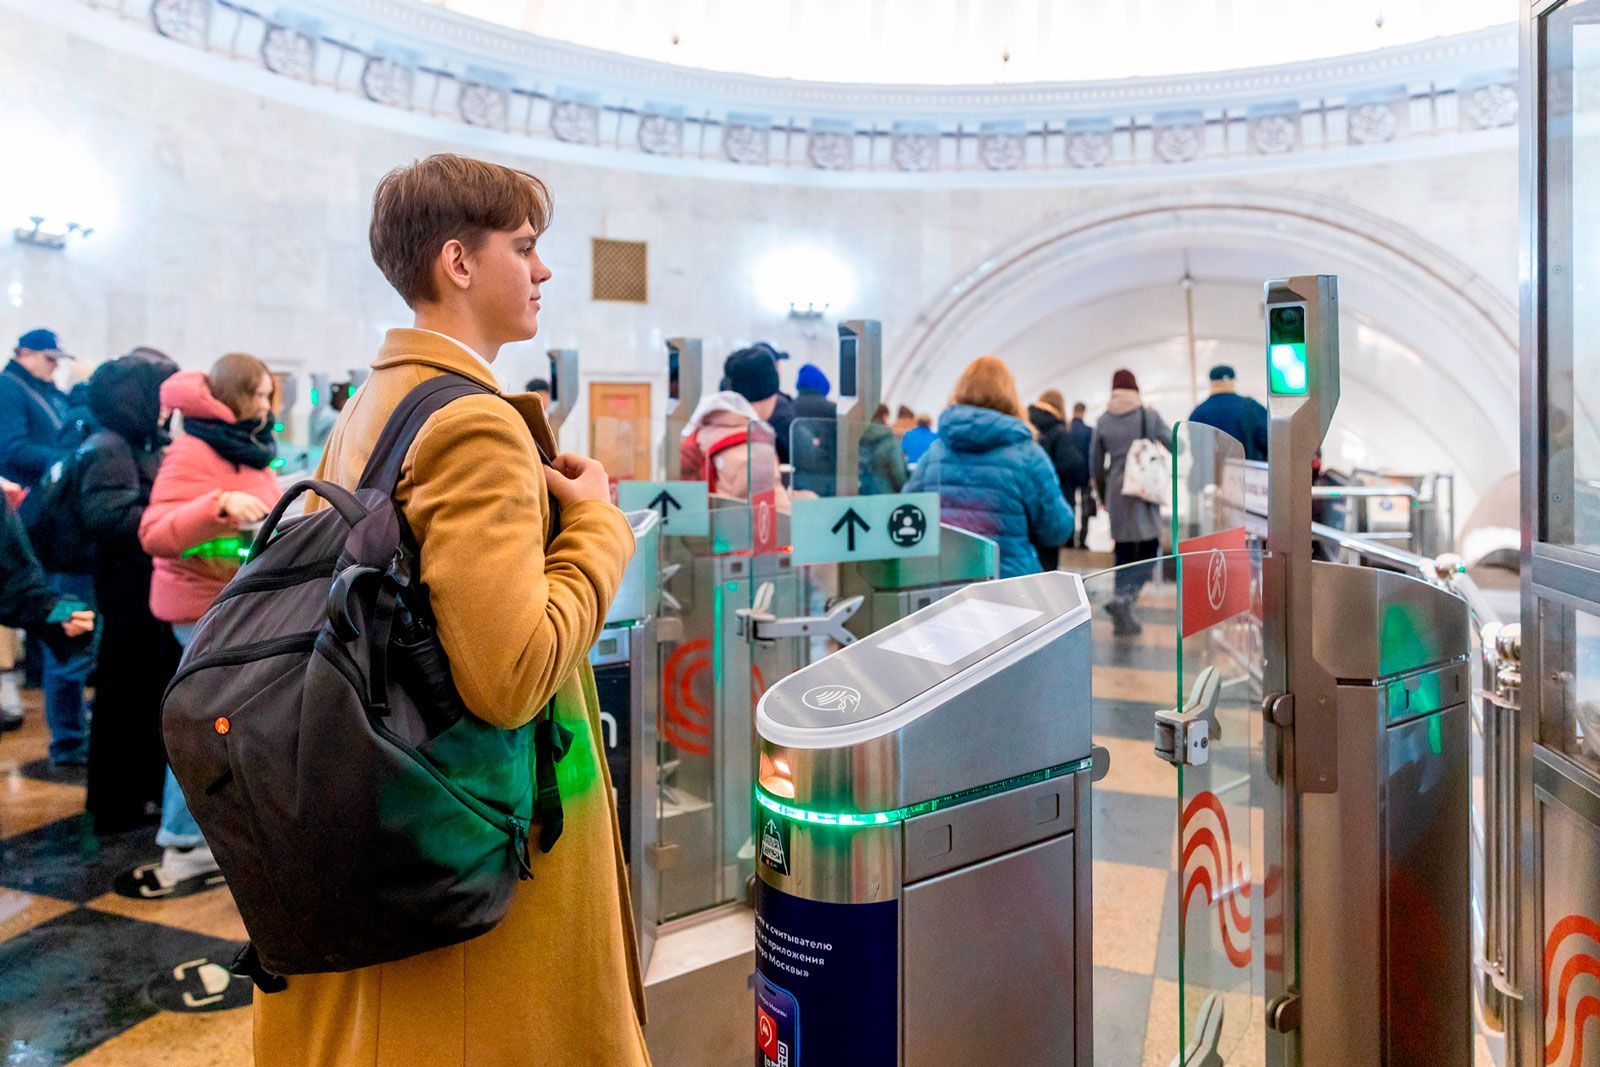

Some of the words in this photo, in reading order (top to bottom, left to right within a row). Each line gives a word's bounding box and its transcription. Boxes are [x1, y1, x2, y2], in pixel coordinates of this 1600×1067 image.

[770, 926, 833, 951] считывателю
[768, 939, 825, 966] приложения
[768, 952, 809, 978] Москвы»
